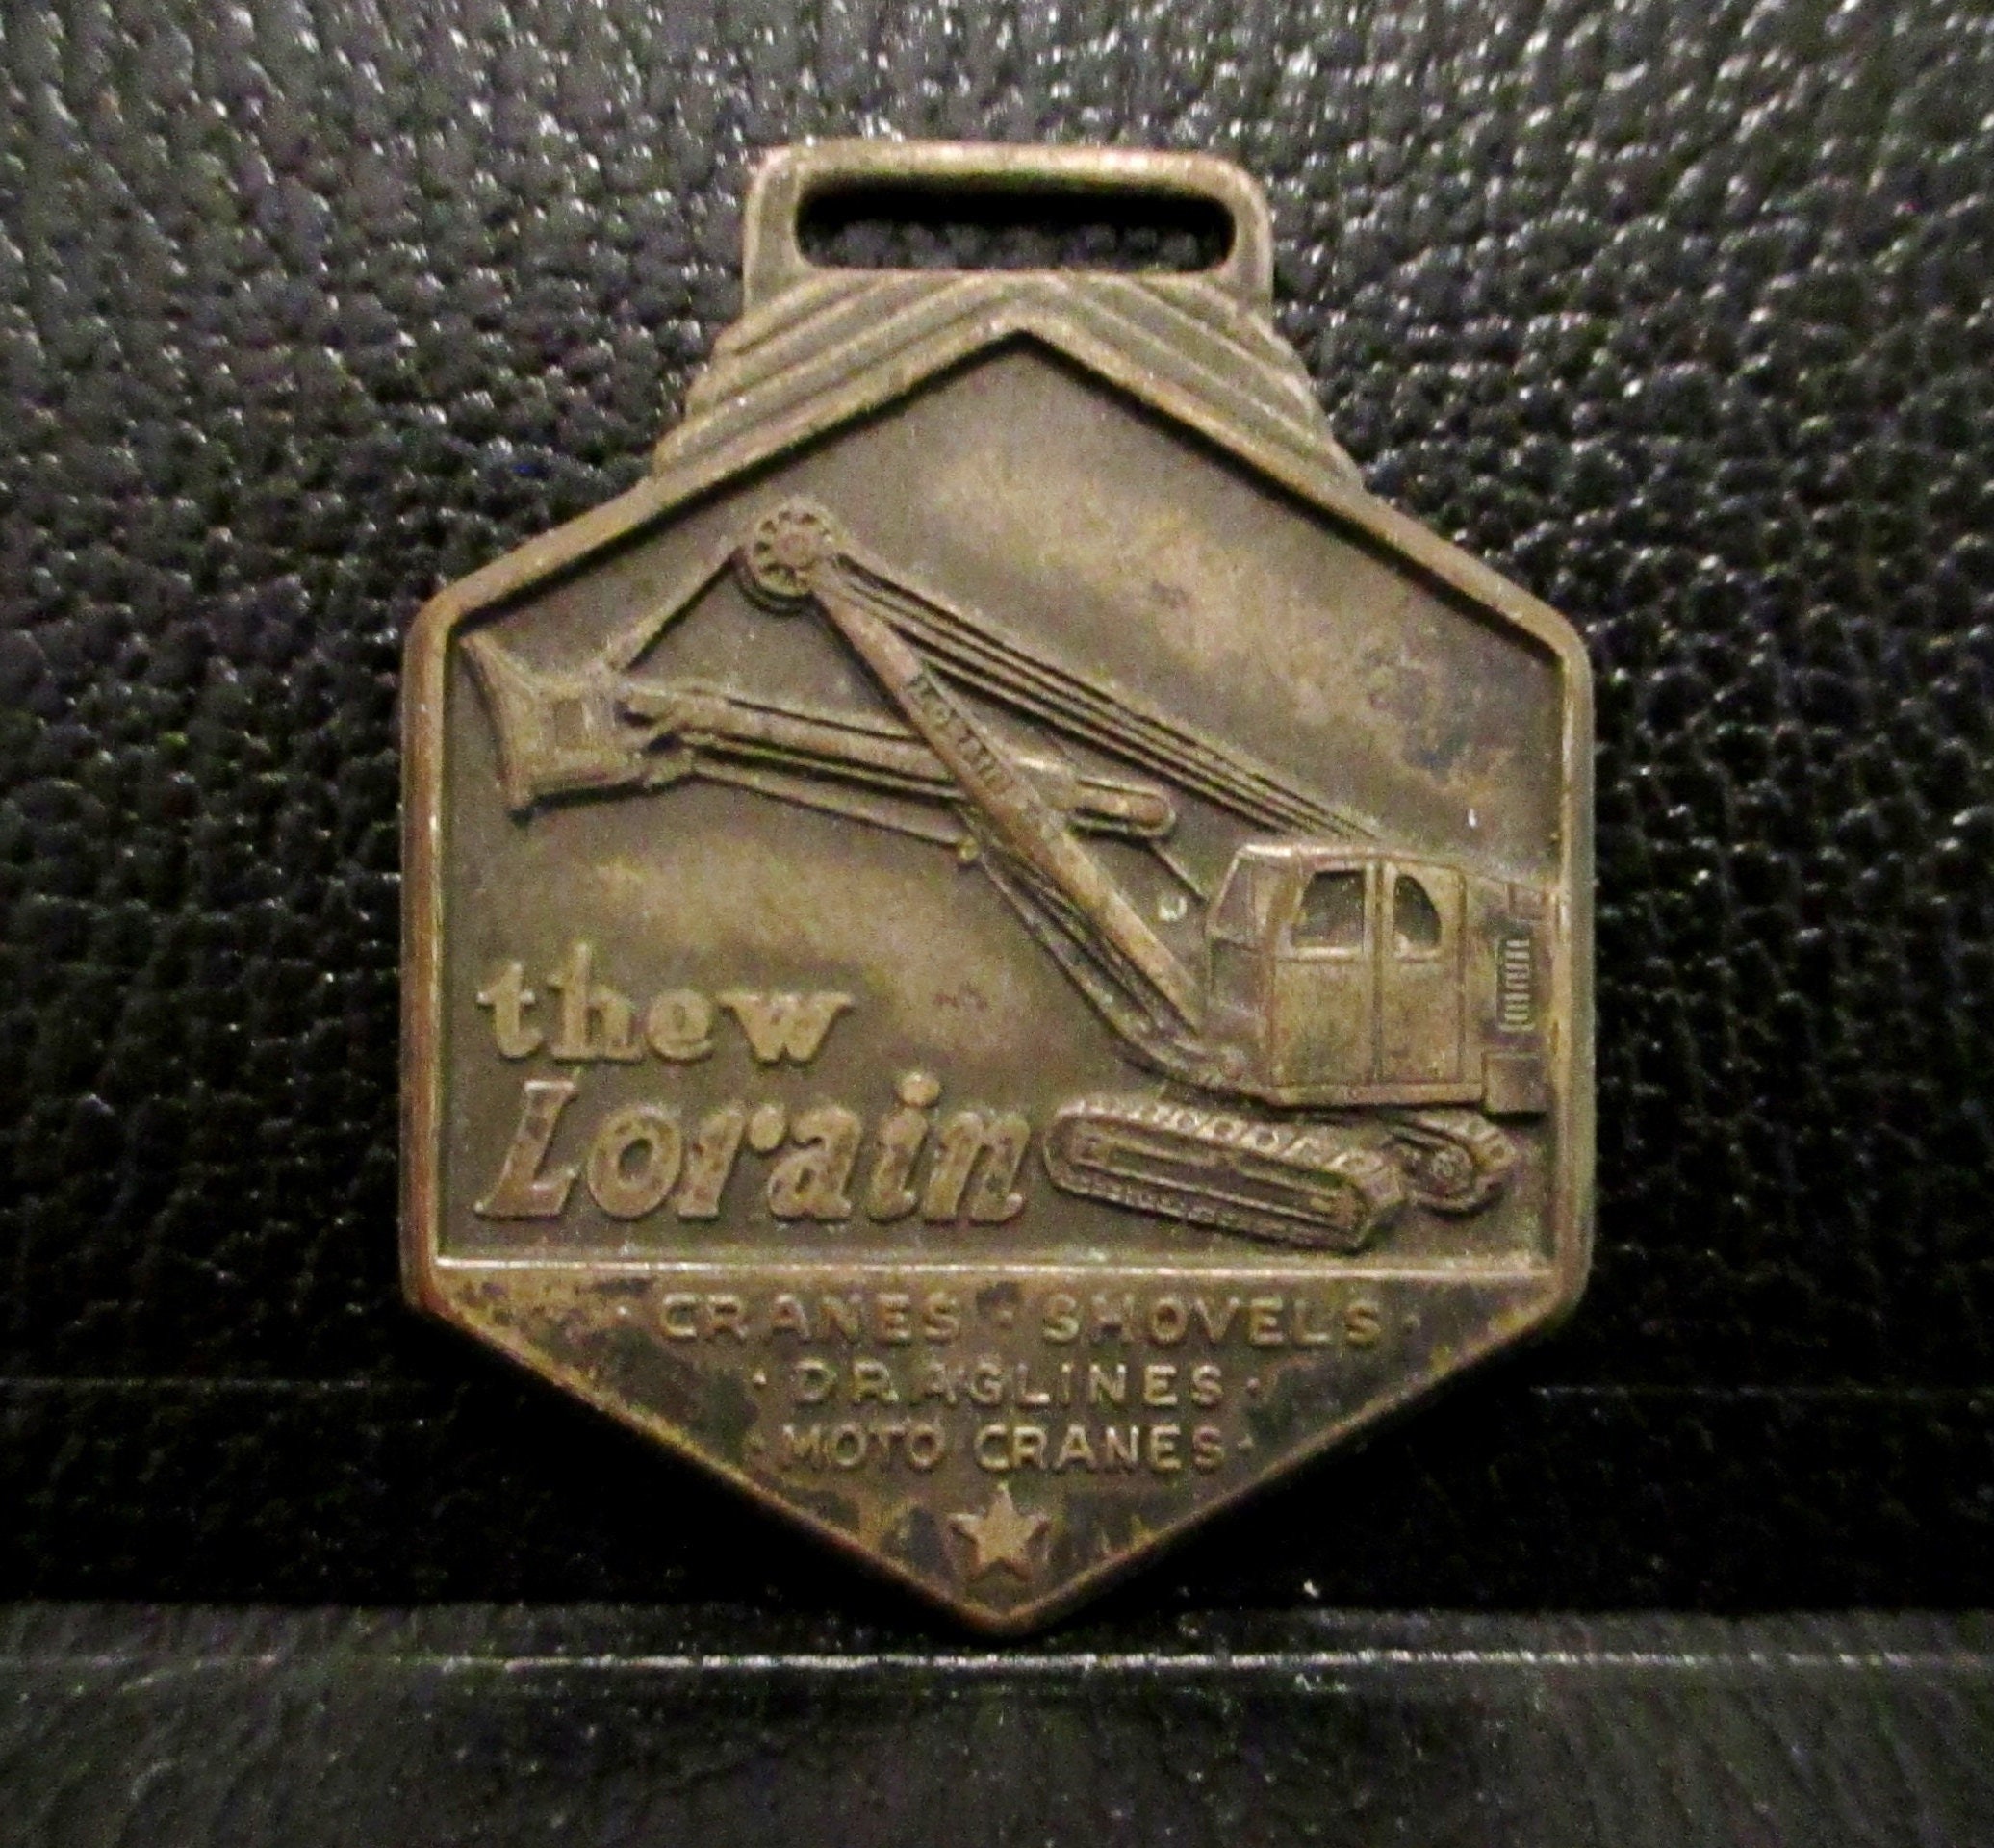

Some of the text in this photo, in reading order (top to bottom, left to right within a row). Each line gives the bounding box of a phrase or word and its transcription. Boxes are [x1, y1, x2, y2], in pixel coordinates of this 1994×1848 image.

[476, 942, 855, 1061] thew
[473, 1071, 1032, 1223] Lorain
[659, 1292, 1384, 1345] CRANES SHOVELS
[792, 1359, 1224, 1408] DRAGLINES
[781, 1424, 1227, 1473] MOTO CRANES
